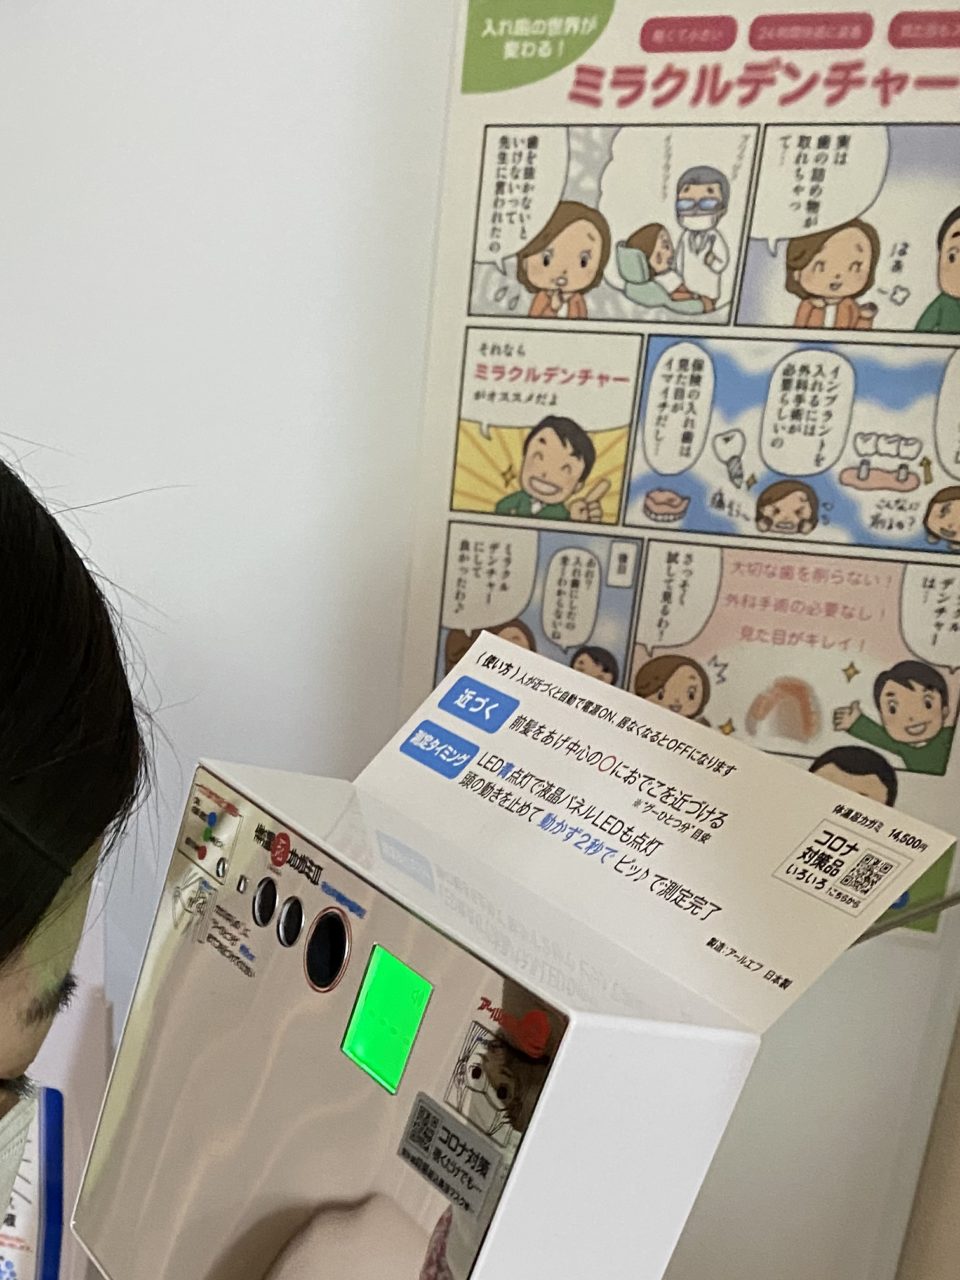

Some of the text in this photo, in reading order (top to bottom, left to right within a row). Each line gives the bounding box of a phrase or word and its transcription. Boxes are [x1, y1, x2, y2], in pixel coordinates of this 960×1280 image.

[481, 15, 598, 39] 入れ歯の世界が
[503, 39, 565, 60] 変わる!
[567, 57, 960, 108] ミラクルデンチャー
[478, 342, 526, 357] それなら
[474, 363, 631, 388] ミラクルデンチャー
[473, 390, 559, 406] がオススメだよ
[770, 362, 796, 449] 必要らしいの
[788, 364, 812, 435] 外科手術が
[803, 364, 826, 437] 入れるには
[814, 366, 840, 468] インプラントを
[740, 624, 866, 651] 見た目がキレイ!
[453, 687, 501, 721] 近づく
[813, 829, 860, 857] コロナ
[796, 845, 846, 878] 対策品
[784, 863, 830, 891] いろいろ
[438, 1126, 492, 1180] コロナ対策
